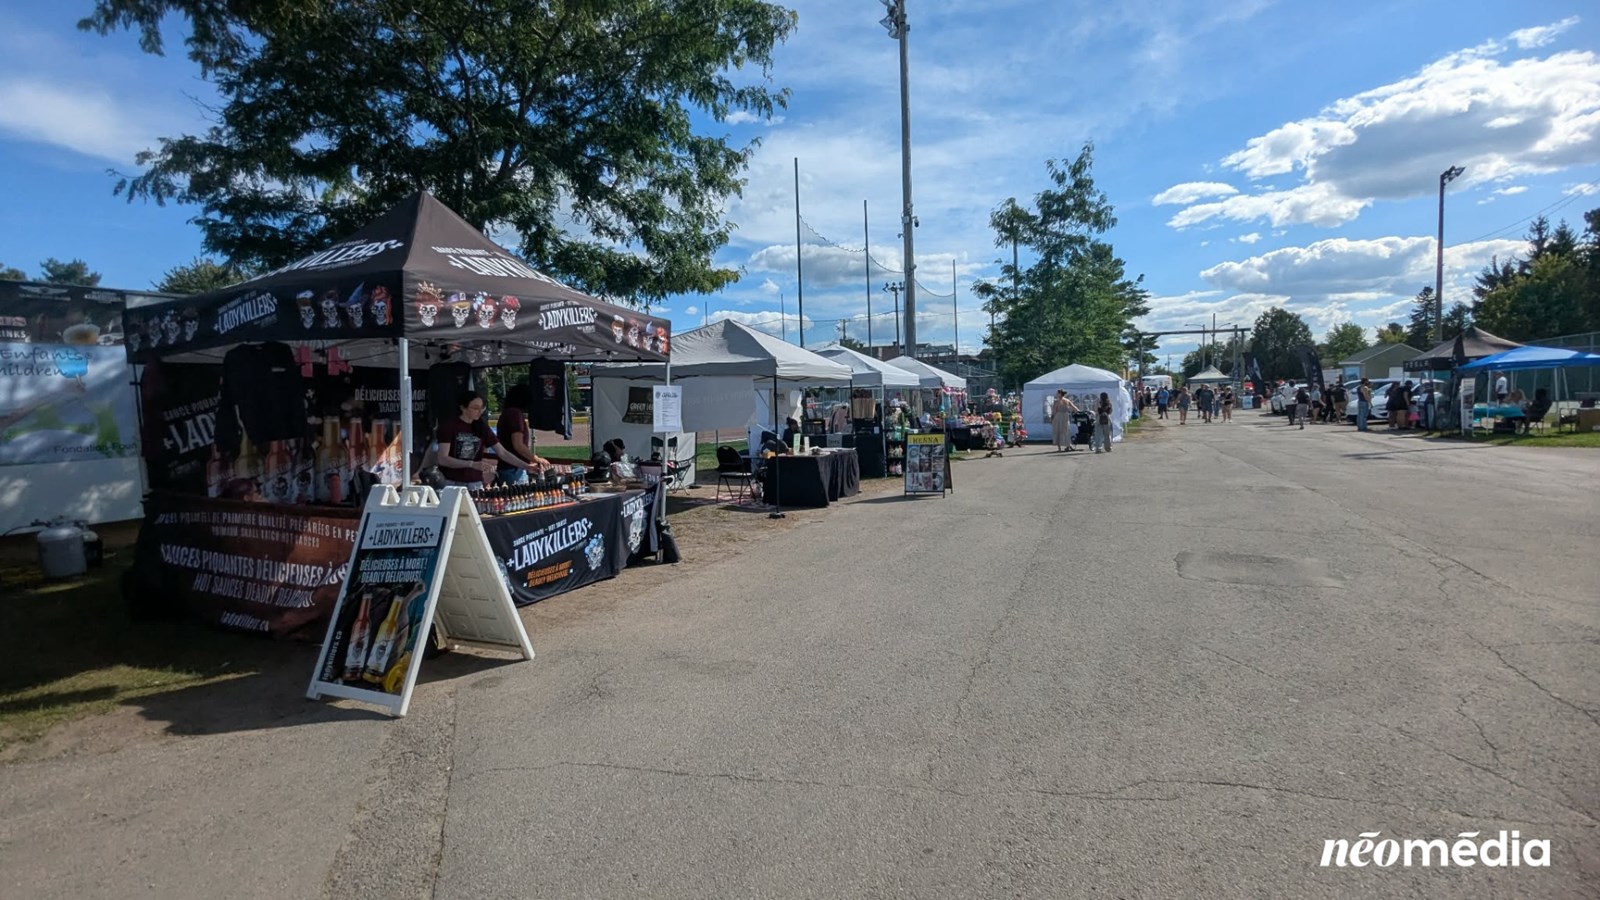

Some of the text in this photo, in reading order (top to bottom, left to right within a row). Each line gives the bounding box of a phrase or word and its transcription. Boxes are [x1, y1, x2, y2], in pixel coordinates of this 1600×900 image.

[218, 292, 276, 334] LADYKILLERS
[540, 306, 595, 331] LADYKILLERS
[355, 385, 401, 401] DÉLICIEUSES
[912, 436, 939, 444] HENNA
[372, 526, 431, 546] LADYKILLERS
[513, 517, 588, 571] LADYKILLERS
[160, 544, 201, 568] SAUCES
[202, 550, 254, 577] PIQUANTES
[256, 554, 324, 587] DÉLICIEUSES
[360, 557, 399, 570] DÉLICIEUSES
[361, 571, 386, 583] DEADLY
[193, 573, 212, 591] HOT
[212, 579, 244, 598] SAUCES
[244, 584, 277, 605] DEADLY
